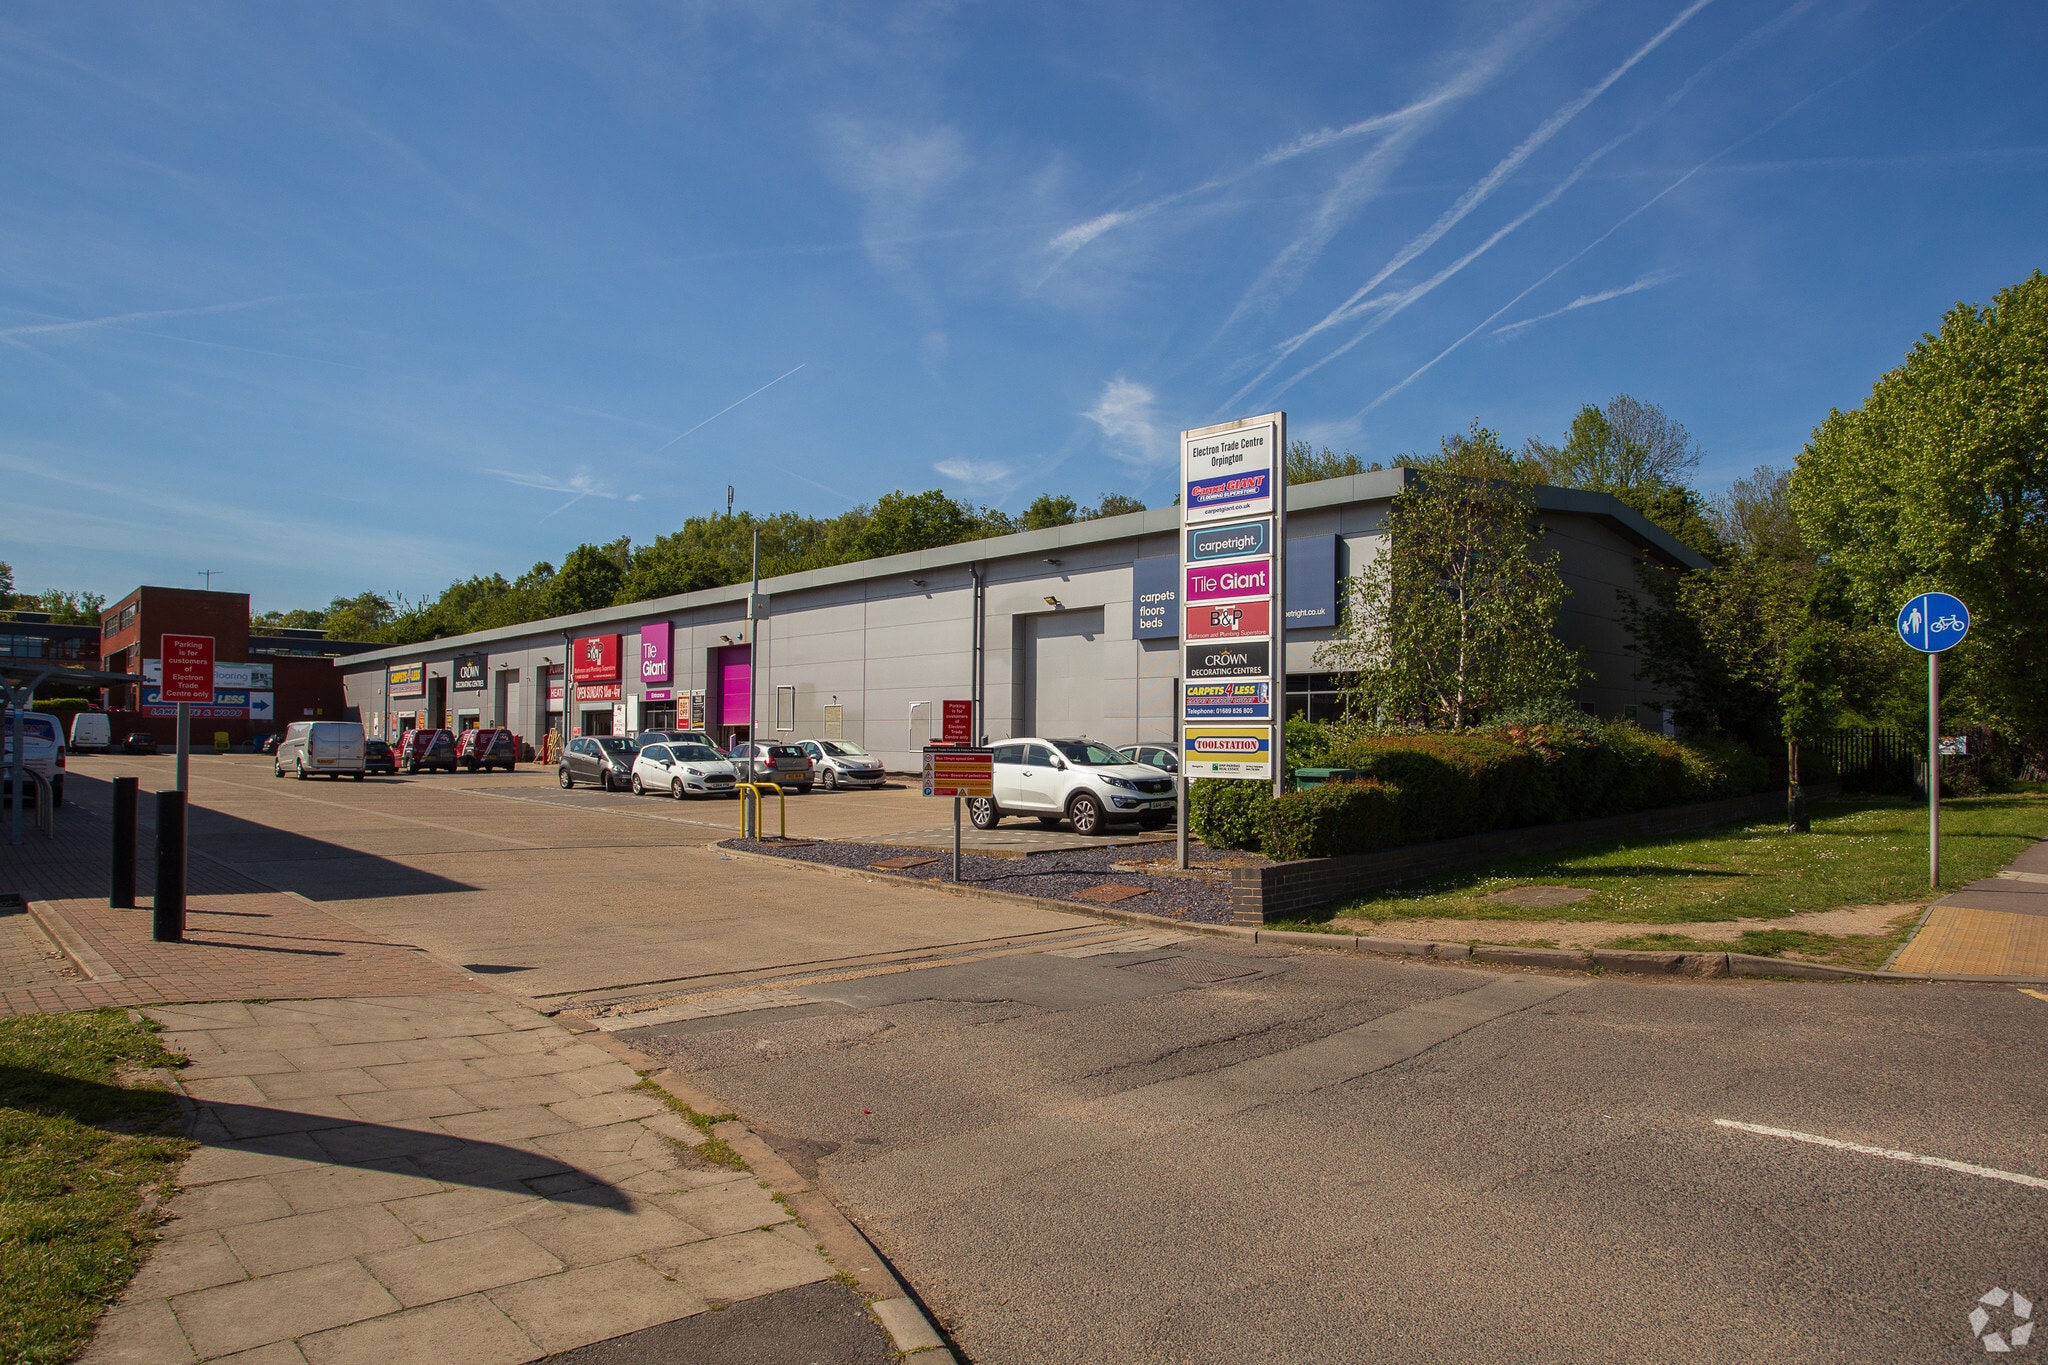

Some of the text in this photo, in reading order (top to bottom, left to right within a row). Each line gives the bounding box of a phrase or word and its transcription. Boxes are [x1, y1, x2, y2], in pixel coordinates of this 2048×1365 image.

[1193, 437, 1264, 458] Electron Trade Centre
[1212, 454, 1243, 467] Orpington
[1192, 475, 1265, 496] Carpet GIANT
[1205, 503, 1250, 514] carpetgiant.co.uk
[1199, 535, 1257, 552] carpetright.
[1191, 571, 1266, 592] Tile Giant
[1140, 591, 1175, 604] carpets
[1140, 606, 1165, 616] floors
[1210, 609, 1243, 626] B&P
[1140, 617, 1162, 628] beds
[174, 640, 202, 649] Parking
[643, 643, 656, 658] Tile
[586, 642, 604, 661] B&P
[1205, 654, 1248, 666] CROWN
[460, 666, 480, 678] CROWN
[642, 660, 666, 676] Giant
[1192, 668, 1232, 676] DECORATING
[577, 686, 586, 699] OPEN
[587, 686, 603, 698] SUNDAYS
[1187, 683, 1255, 697] CARPETS 4 LESS
[217, 695, 245, 704] LESS
[1197, 741, 1256, 749] TOOLSTATION
